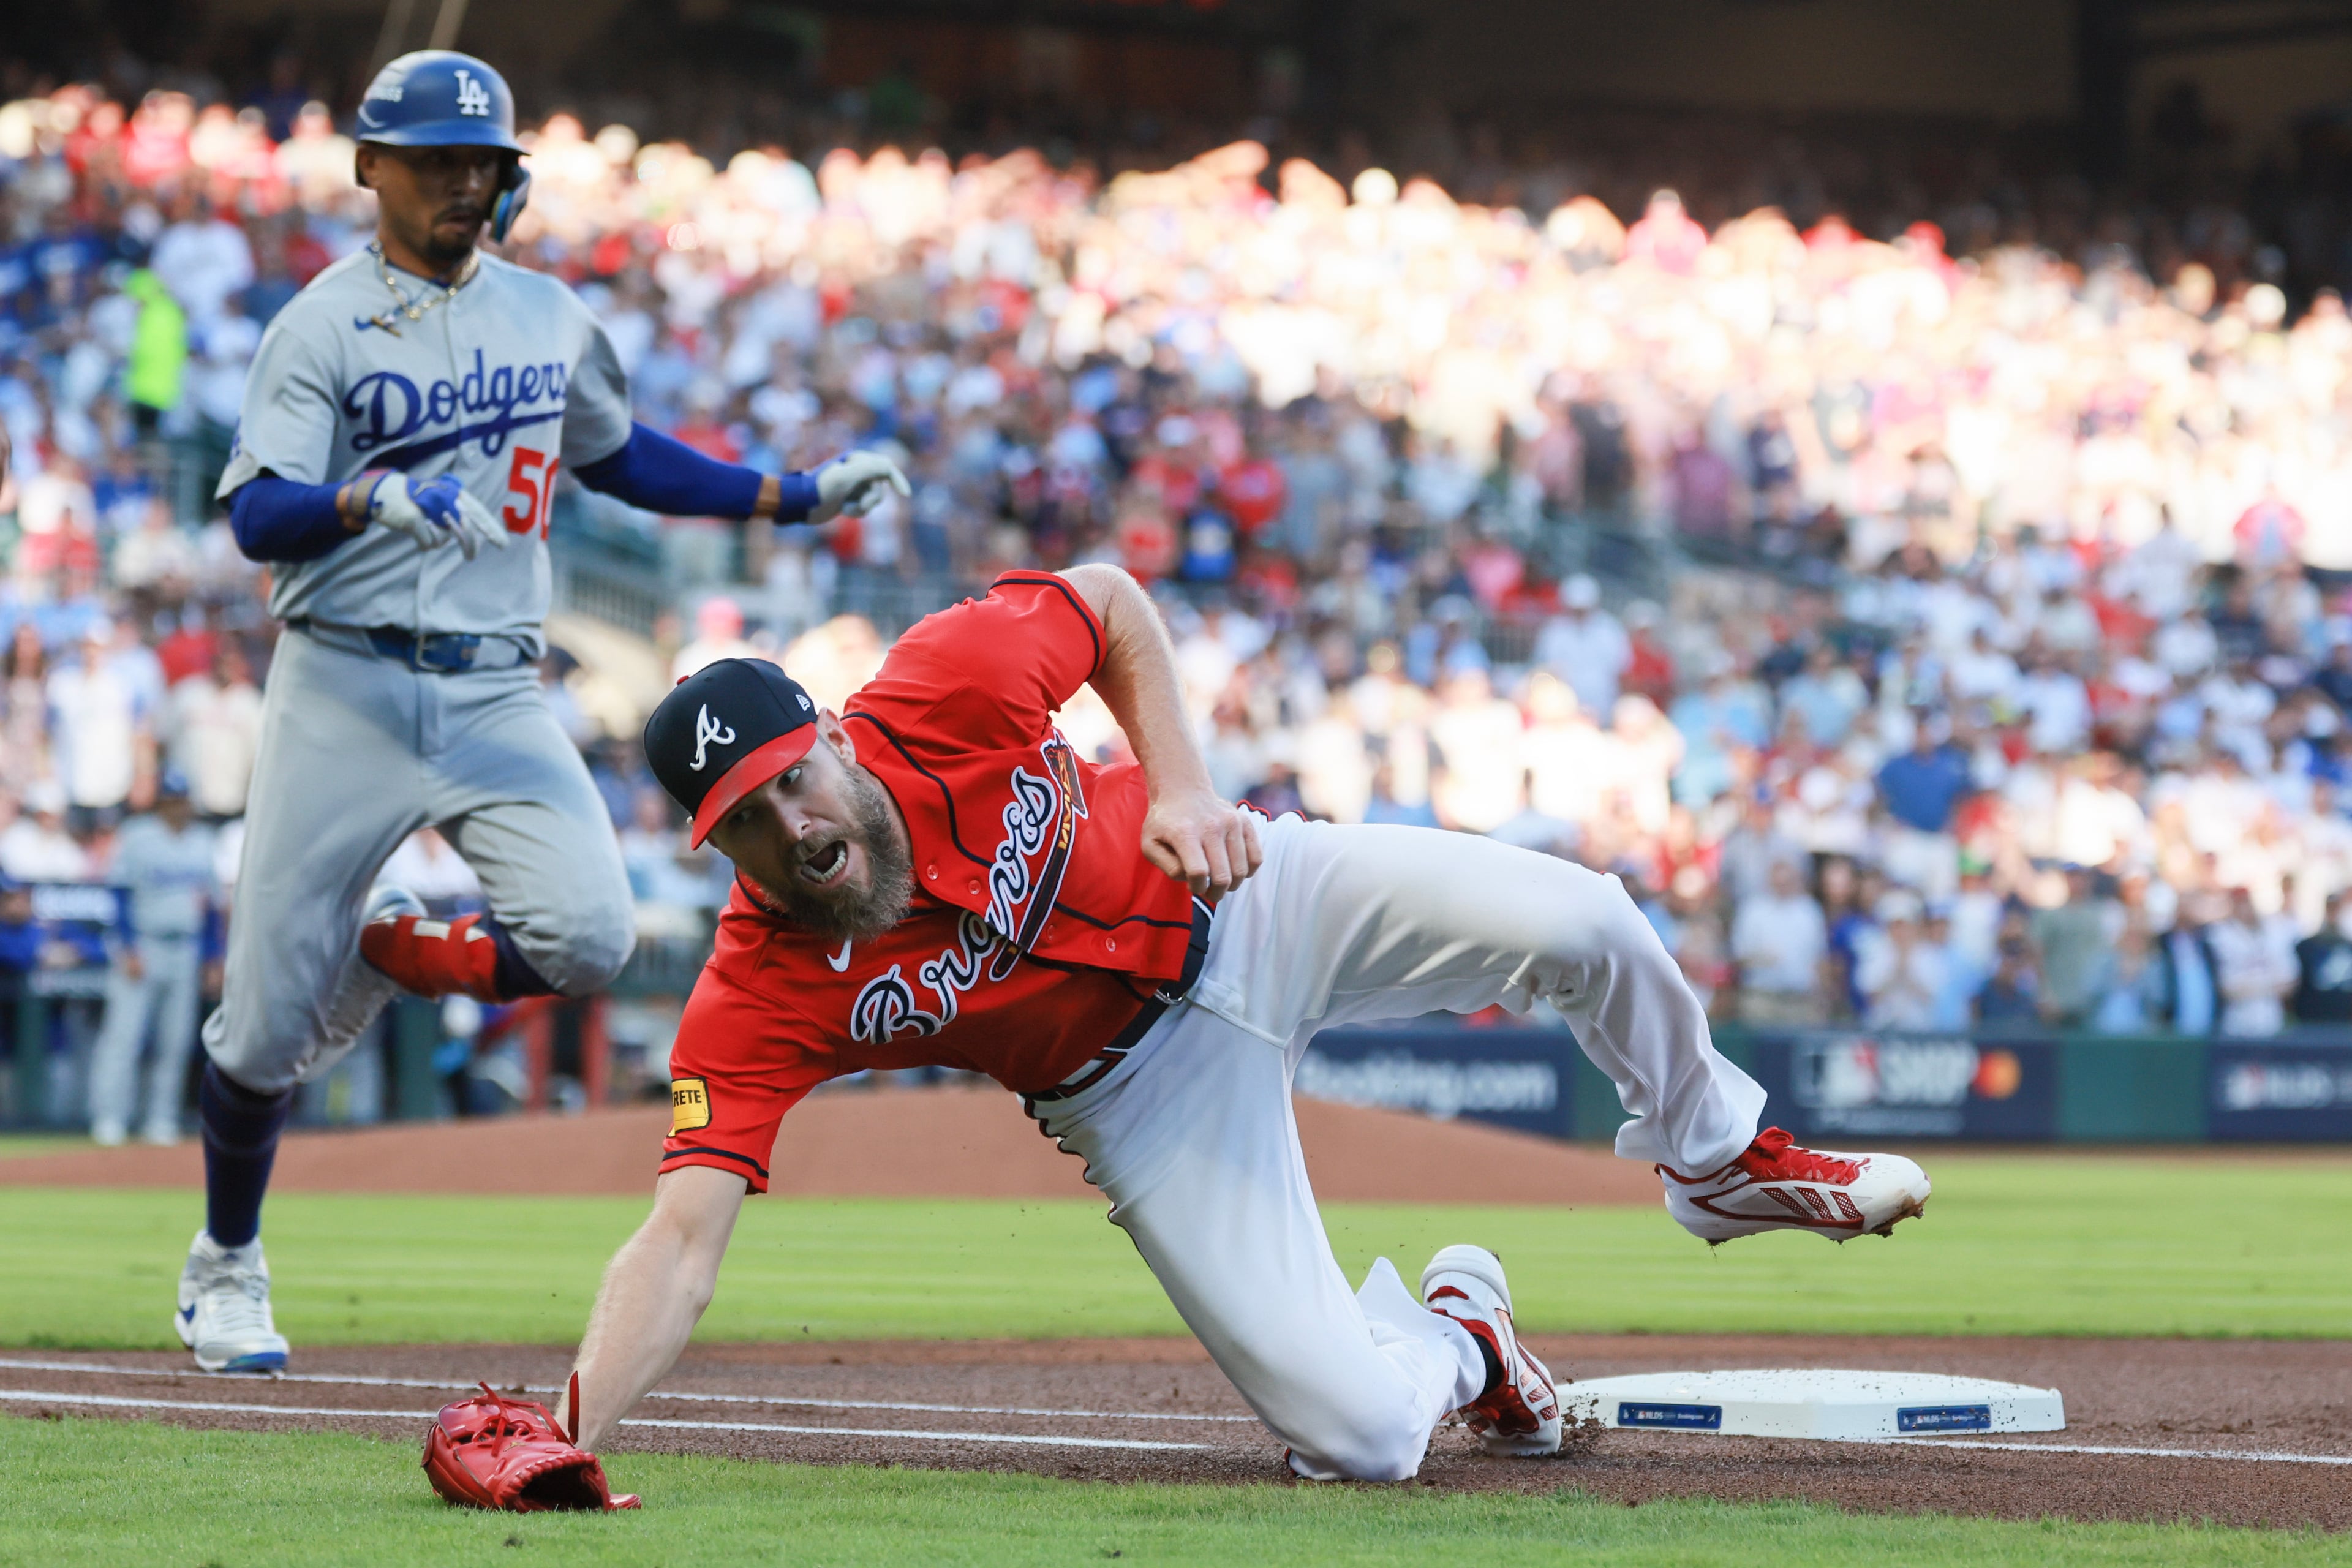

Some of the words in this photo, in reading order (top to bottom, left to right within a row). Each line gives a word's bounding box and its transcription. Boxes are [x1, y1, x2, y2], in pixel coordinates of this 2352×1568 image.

[454, 70, 489, 116] LA
[690, 703, 736, 772] A
[850, 766, 1057, 1045] Braves
